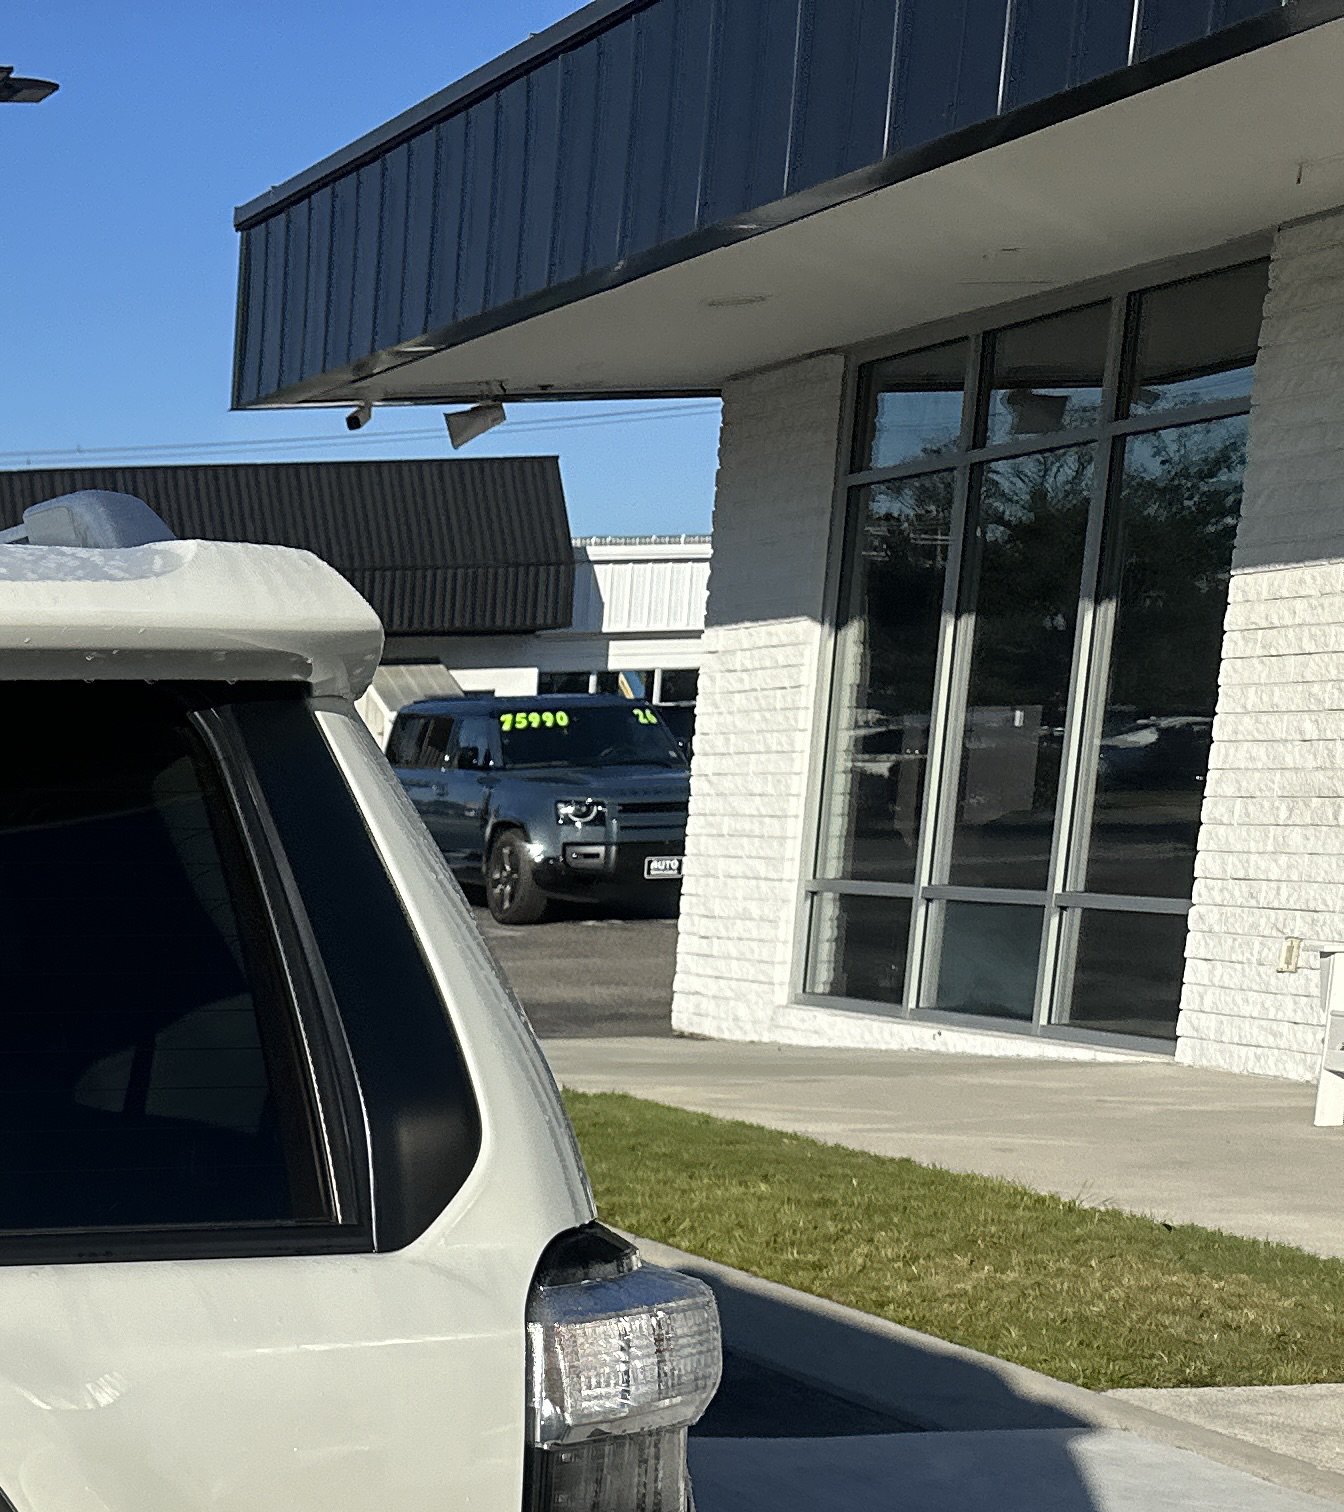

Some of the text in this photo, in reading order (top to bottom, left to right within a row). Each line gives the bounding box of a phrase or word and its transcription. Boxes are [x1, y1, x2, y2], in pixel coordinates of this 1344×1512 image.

[500, 708, 658, 731] 75990 26
[650, 859, 679, 870] AUTO
